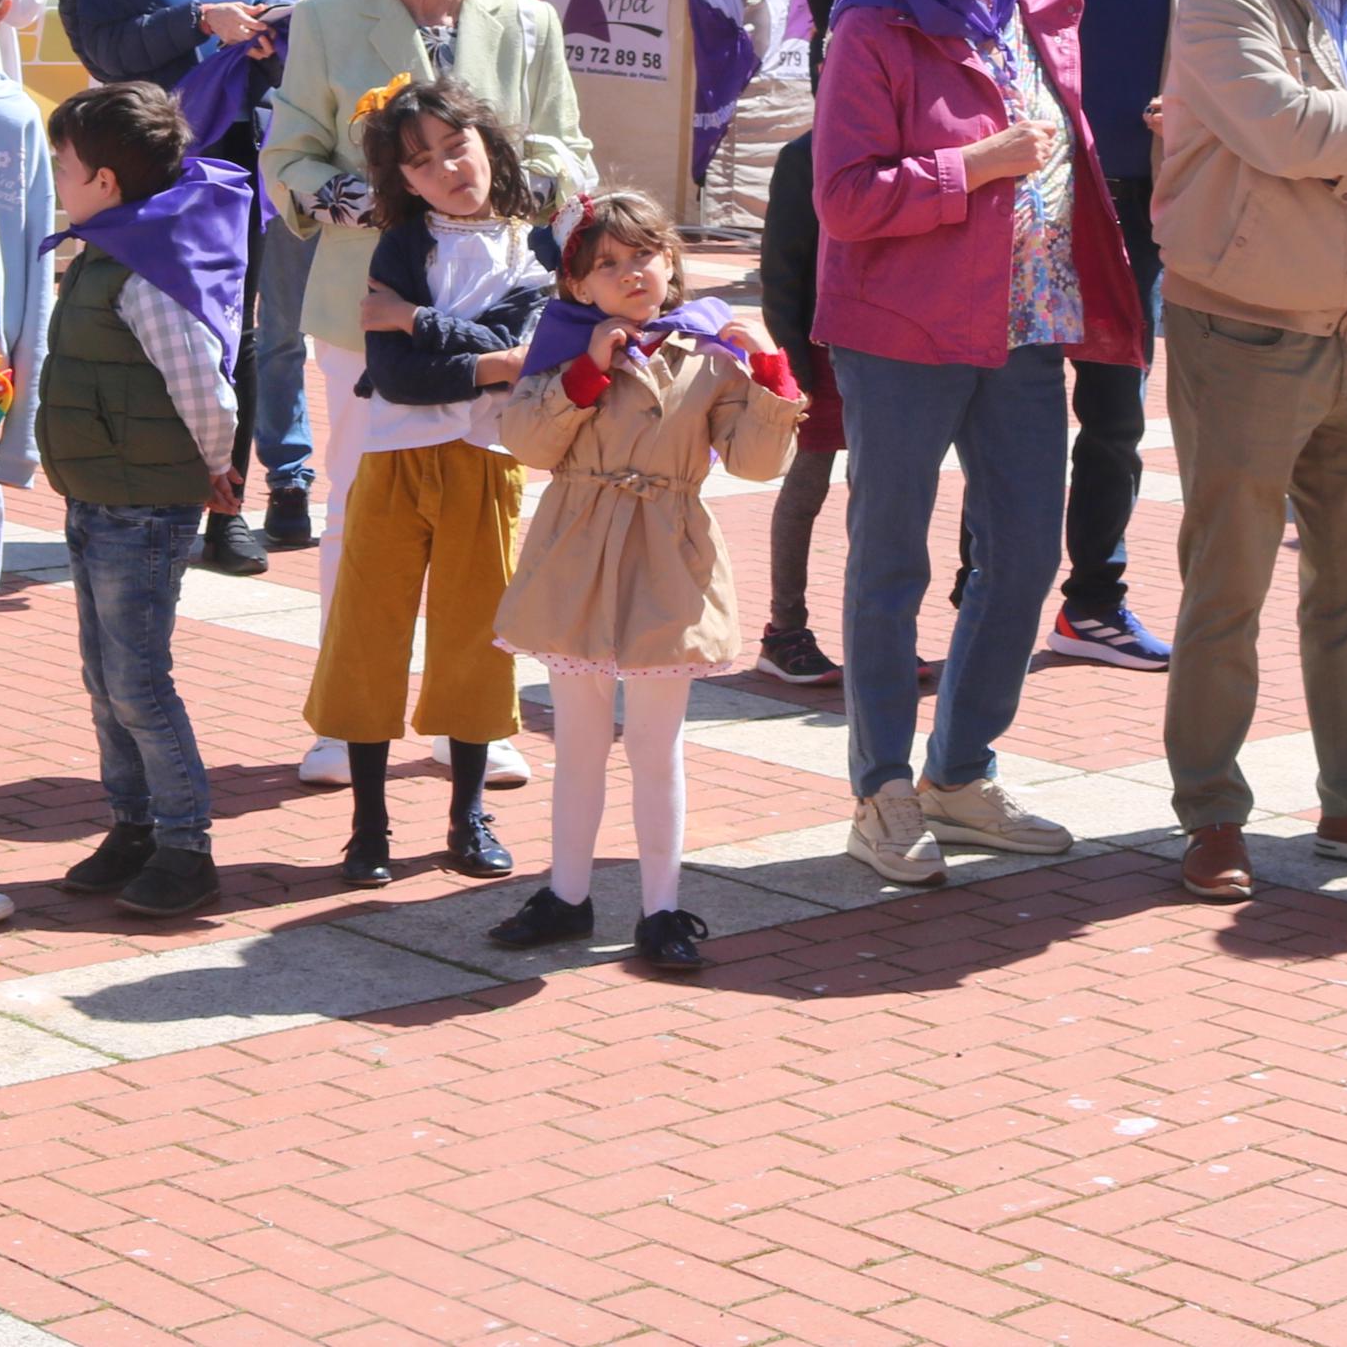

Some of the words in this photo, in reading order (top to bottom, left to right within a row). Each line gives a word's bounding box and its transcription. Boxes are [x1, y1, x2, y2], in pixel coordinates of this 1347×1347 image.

[565, 44, 585, 62] 79
[590, 46, 610, 64] 72
[615, 49, 637, 66] 89
[642, 52, 662, 70] 58
